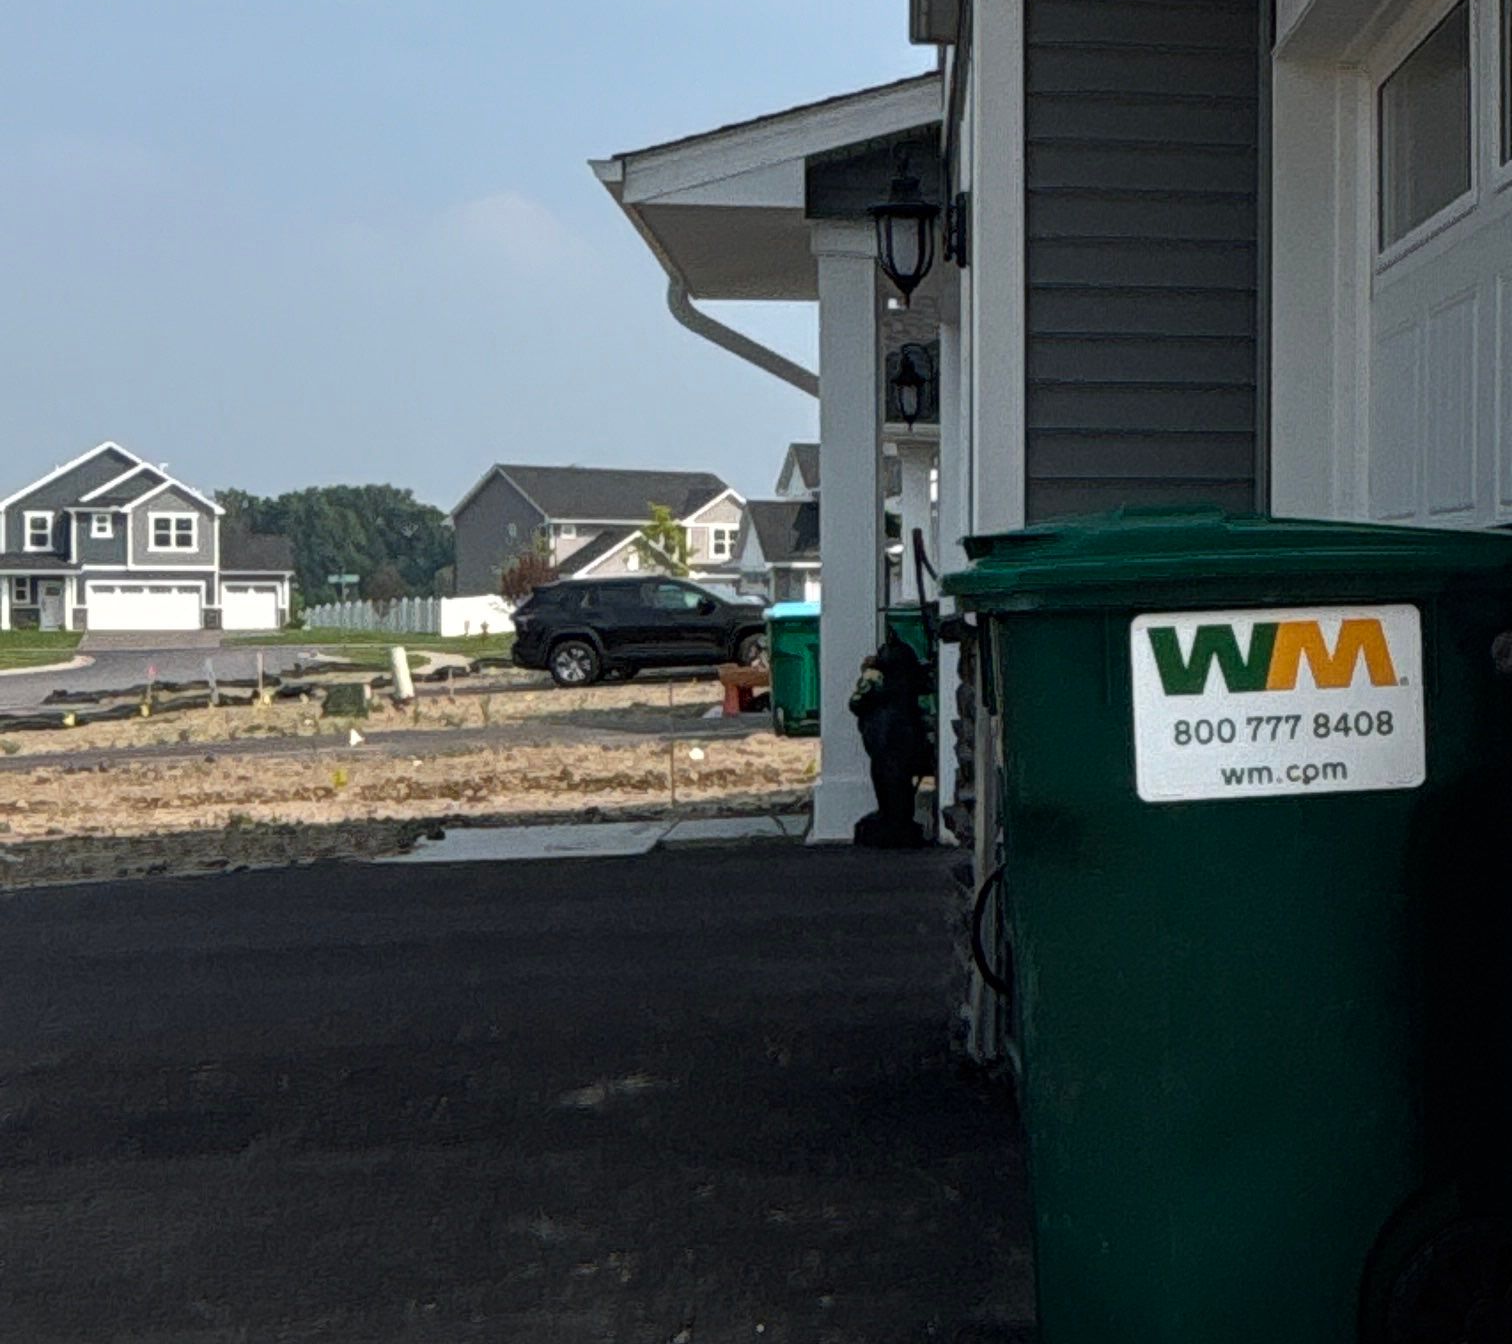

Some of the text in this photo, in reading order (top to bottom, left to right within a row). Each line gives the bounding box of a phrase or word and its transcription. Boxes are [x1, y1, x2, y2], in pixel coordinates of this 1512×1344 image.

[1147, 618, 1399, 696] WM
[1173, 710, 1394, 746] 800 777 8408
